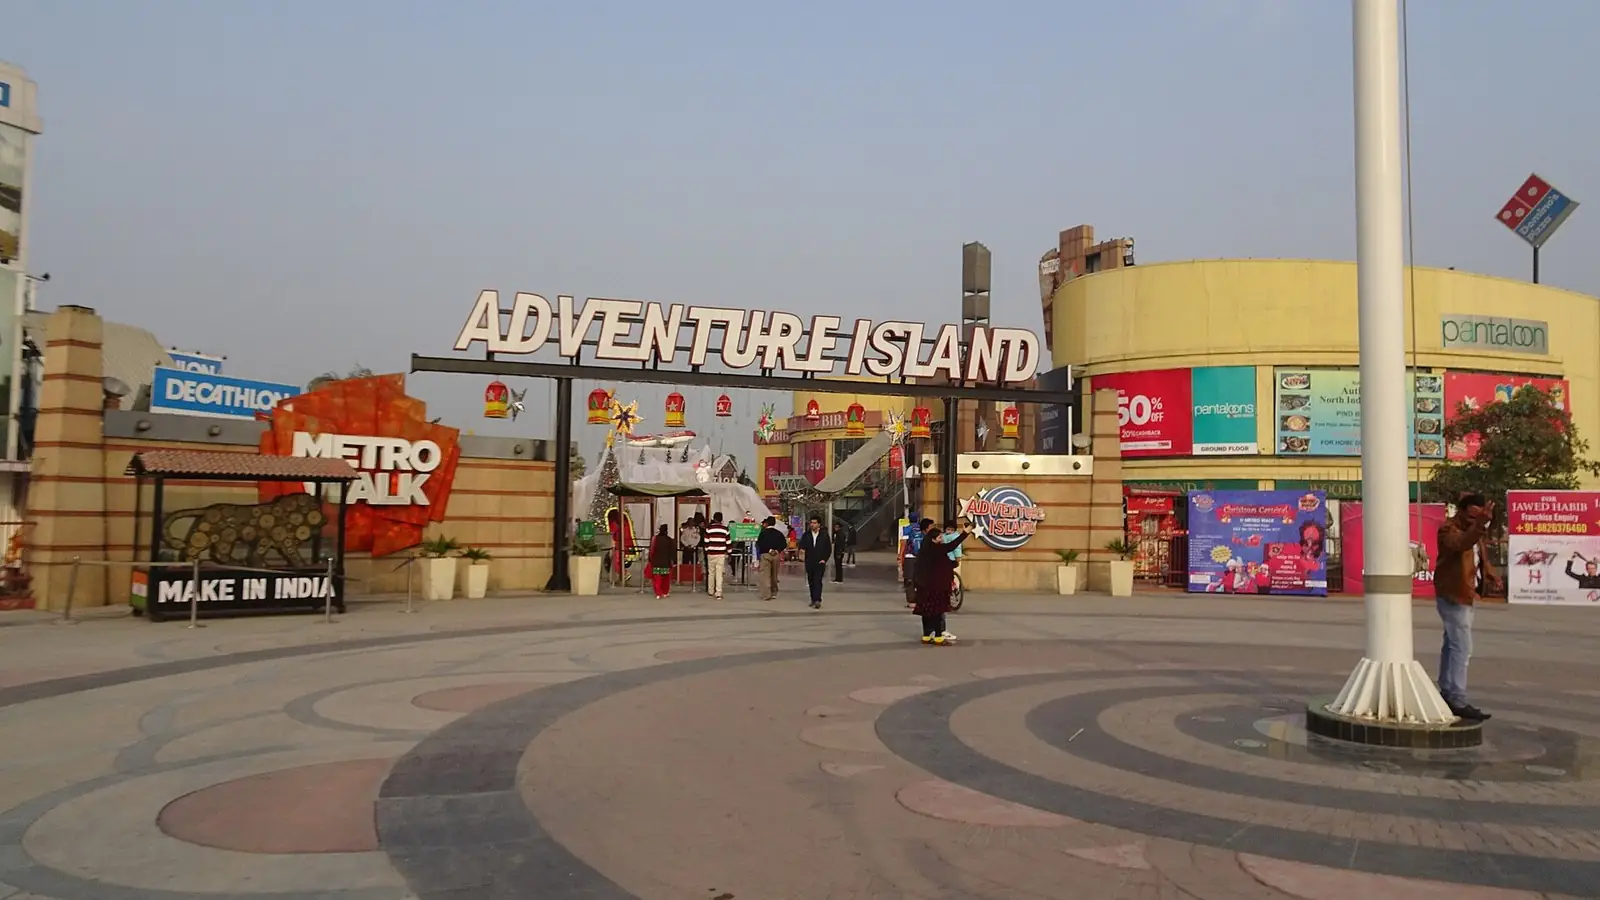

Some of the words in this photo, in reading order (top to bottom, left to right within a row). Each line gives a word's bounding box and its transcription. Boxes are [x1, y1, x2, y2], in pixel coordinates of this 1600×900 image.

[453, 290, 842, 373] ADVENTURE
[845, 319, 1040, 383] ISLAND
[1441, 317, 1546, 349] pantaloon
[165, 377, 294, 413] DECATHLON
[1319, 396, 1345, 405] North
[1151, 411, 1164, 423] OFF
[1194, 402, 1255, 418] pantaloons
[291, 431, 442, 472] METRO
[1310, 483, 1361, 497] WOODL
[967, 498, 1046, 521] ADVENTURE
[1511, 502, 1550, 512] JAWED
[1552, 502, 1588, 512] HABIB
[1521, 512, 1553, 521] Franchise
[1553, 512, 1579, 522] Enquiry
[988, 519, 1038, 536] ISLAND
[157, 578, 235, 603] MAKE
[241, 577, 267, 600] IN
[273, 576, 336, 599] INDIA
